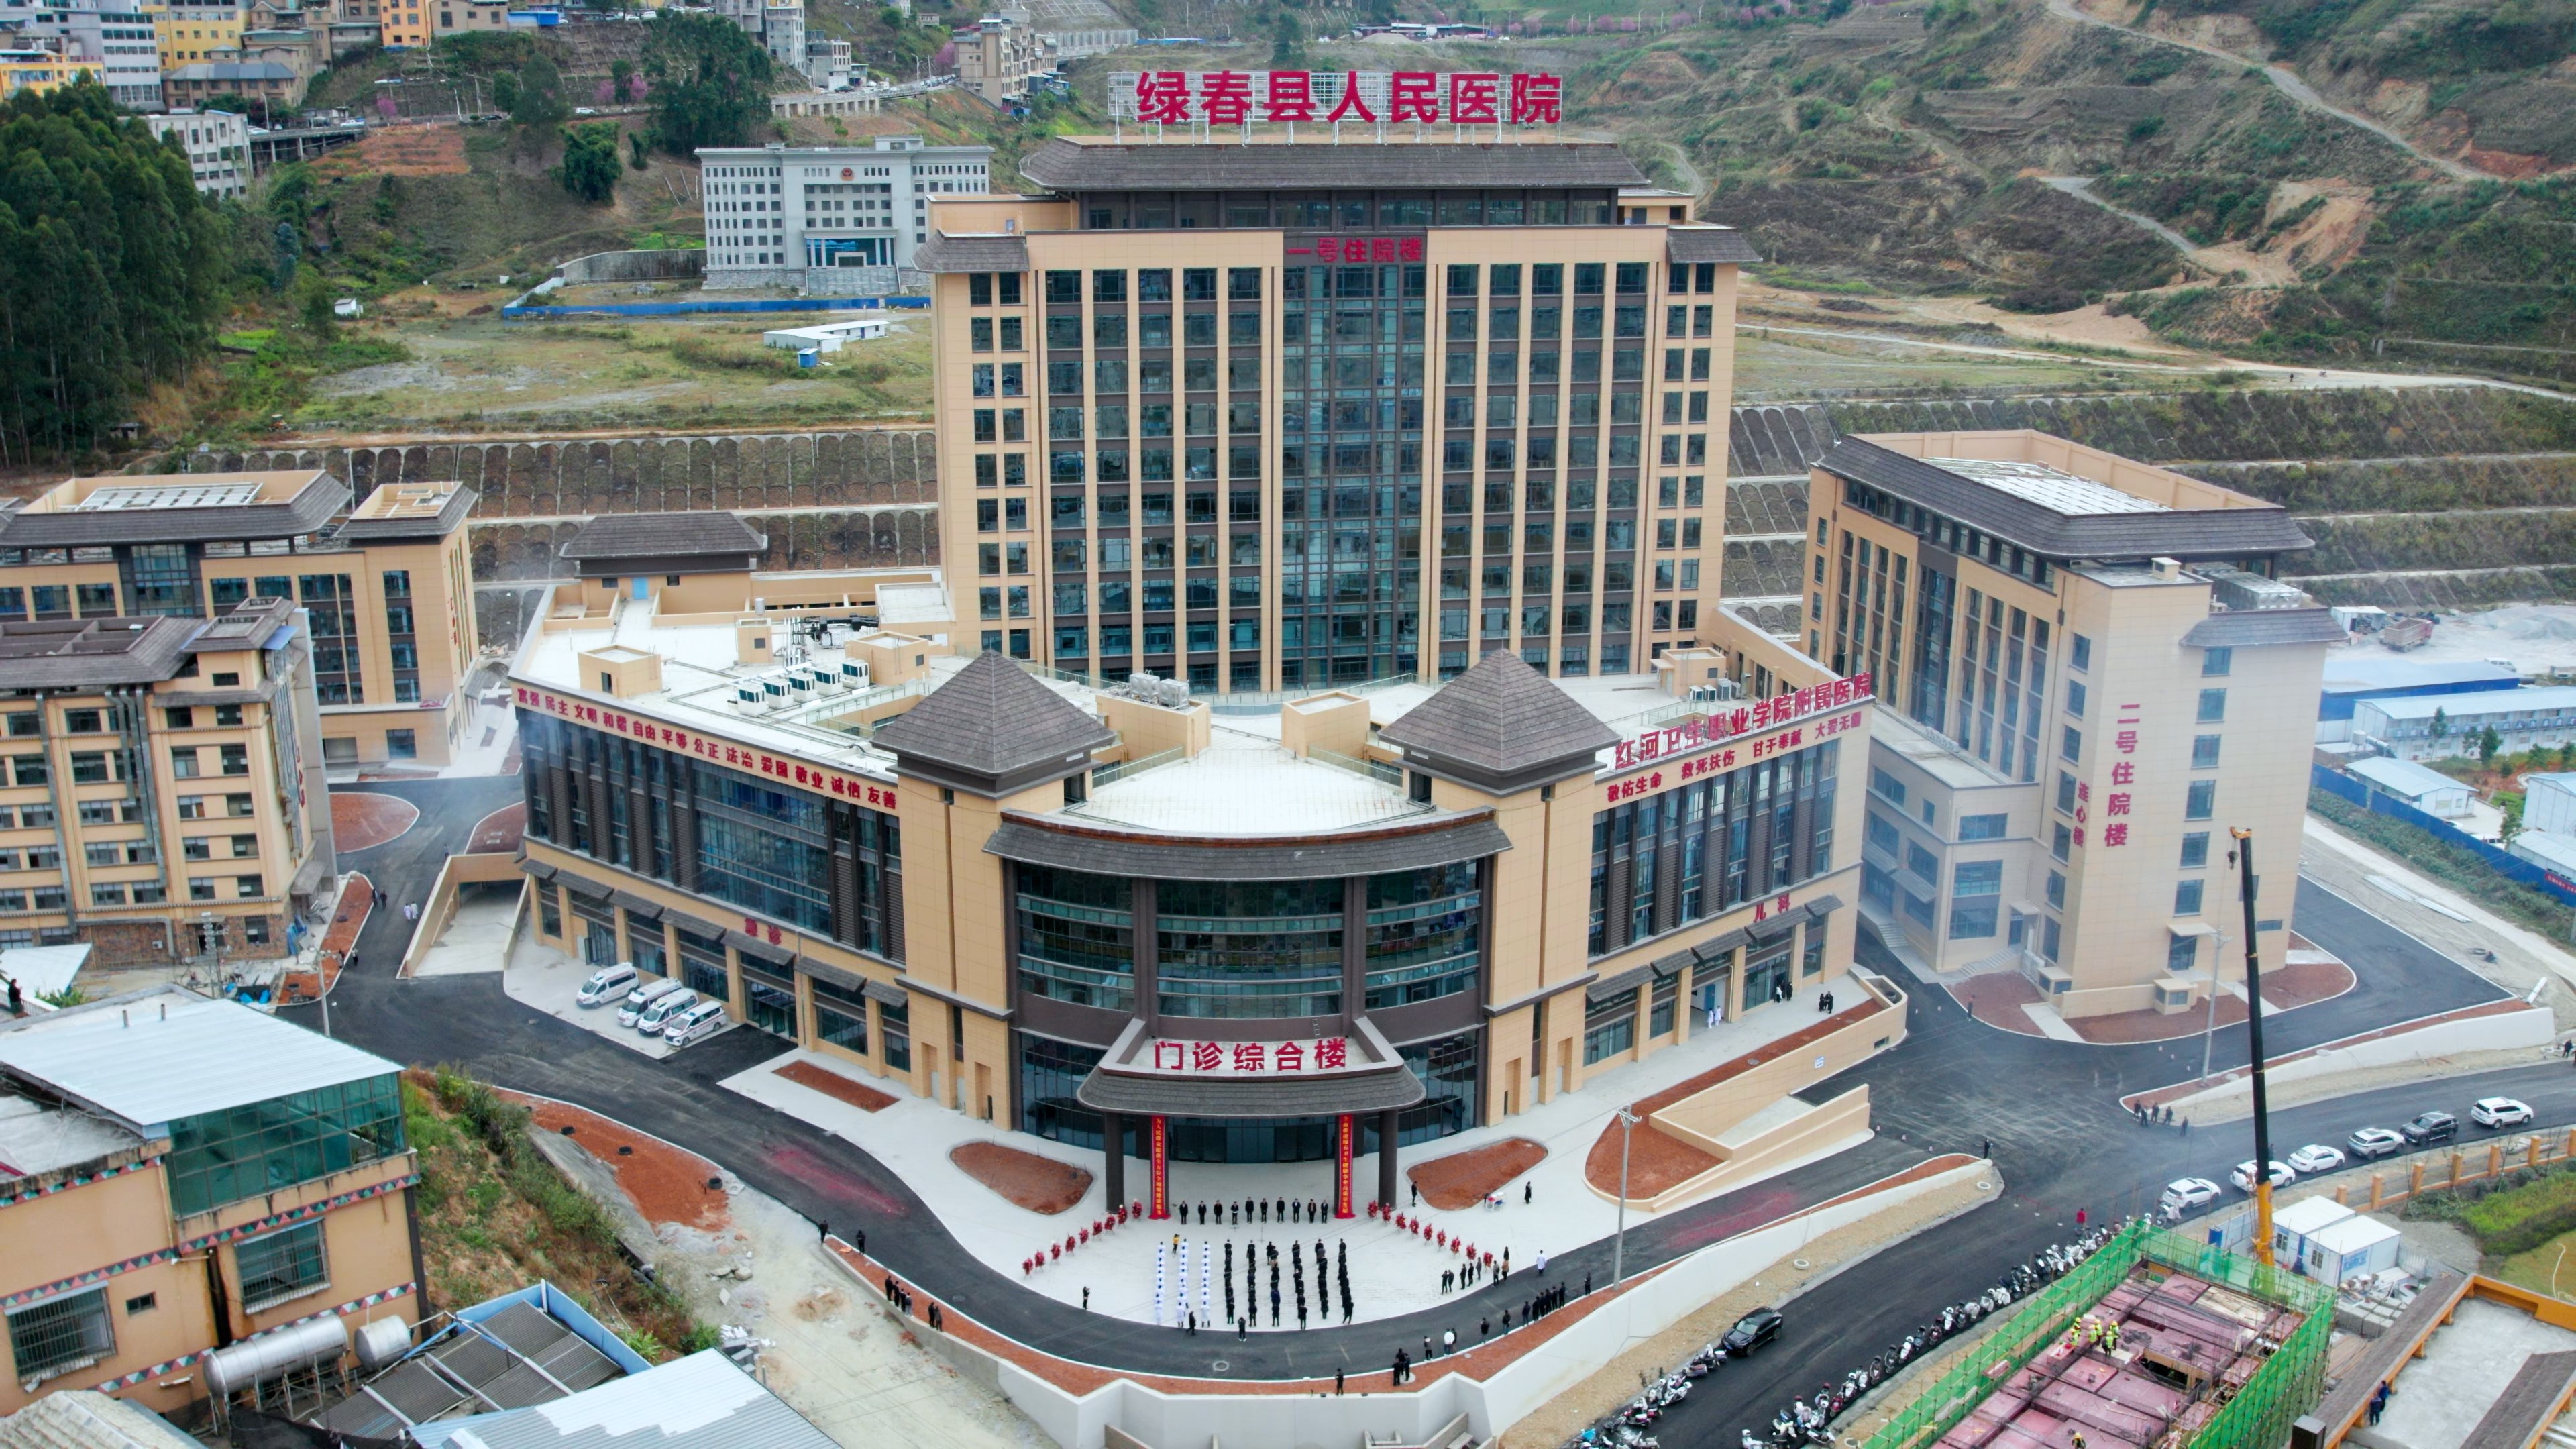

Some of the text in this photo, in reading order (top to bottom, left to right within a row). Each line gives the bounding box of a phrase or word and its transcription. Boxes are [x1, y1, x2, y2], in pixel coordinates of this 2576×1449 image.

[1136, 70, 1562, 125] 绿春县人民医院
[1287, 237, 1422, 263] 一号住院楼
[517, 688, 898, 810] 富强 民主 文明 和谐 自由 平等 公正 法治 爱国 敬业 诚信 友善
[1615, 671, 1872, 771] 红河卫生职业学院附属医院
[1607, 772, 1662, 803] 敬佑生命
[1682, 749, 1735, 780] 救死扶伤
[1753, 729, 1802, 757] 甘于奉献
[2104, 703, 2140, 847] 二号住院楼
[1753, 893, 1790, 922] 儿科
[1154, 1038, 1346, 1072] 门诊综合楼
